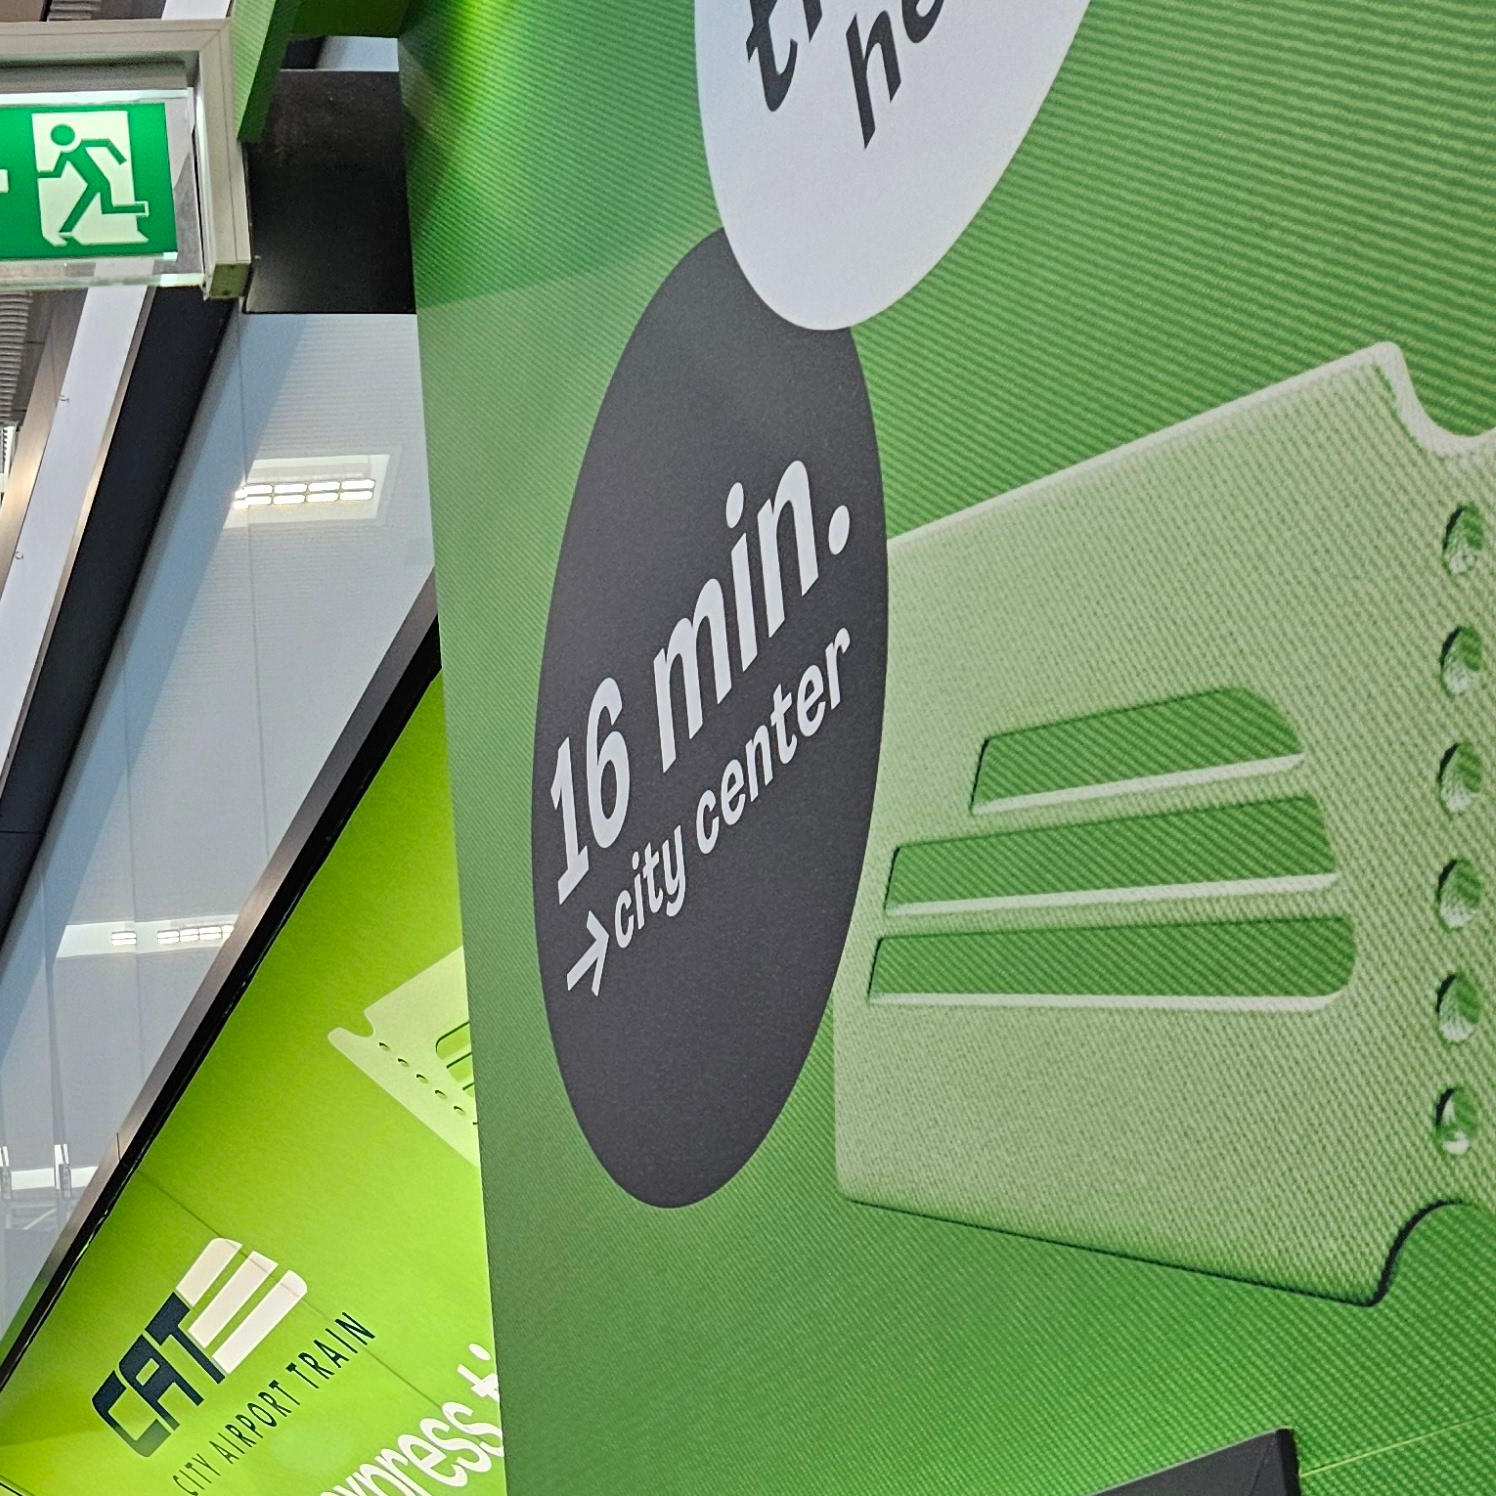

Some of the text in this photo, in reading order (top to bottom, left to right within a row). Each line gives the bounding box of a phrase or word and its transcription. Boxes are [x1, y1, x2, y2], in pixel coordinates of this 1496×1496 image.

[550, 459, 851, 905] 16 min.
[614, 627, 851, 949] city center
[172, 1453, 221, 1496] CITY
[209, 1379, 301, 1465] AIRPORT
[285, 1311, 377, 1389] TRAIN
